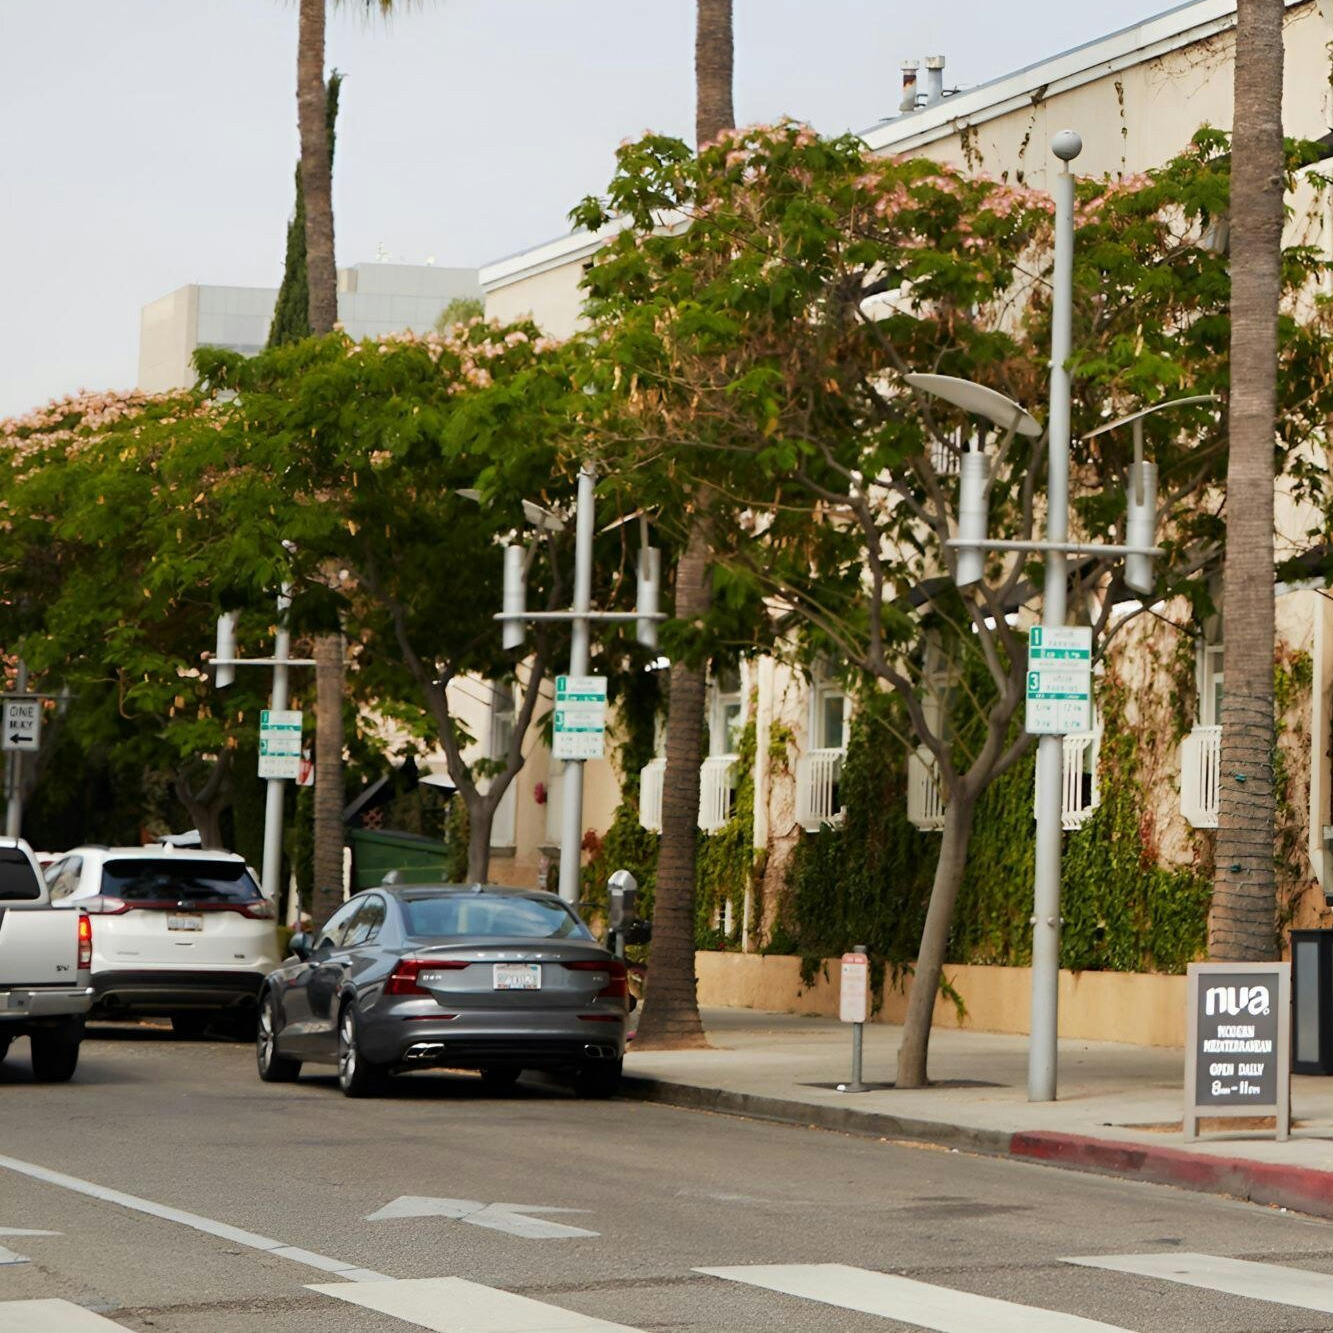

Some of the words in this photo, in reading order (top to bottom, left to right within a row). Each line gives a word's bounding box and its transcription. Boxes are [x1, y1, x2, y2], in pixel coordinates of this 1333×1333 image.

[1030, 673, 1037, 690] 3
[10, 706, 34, 718] ONE
[1209, 1063, 1234, 1076] OPEN
[1238, 1063, 1264, 1076] DAILY
